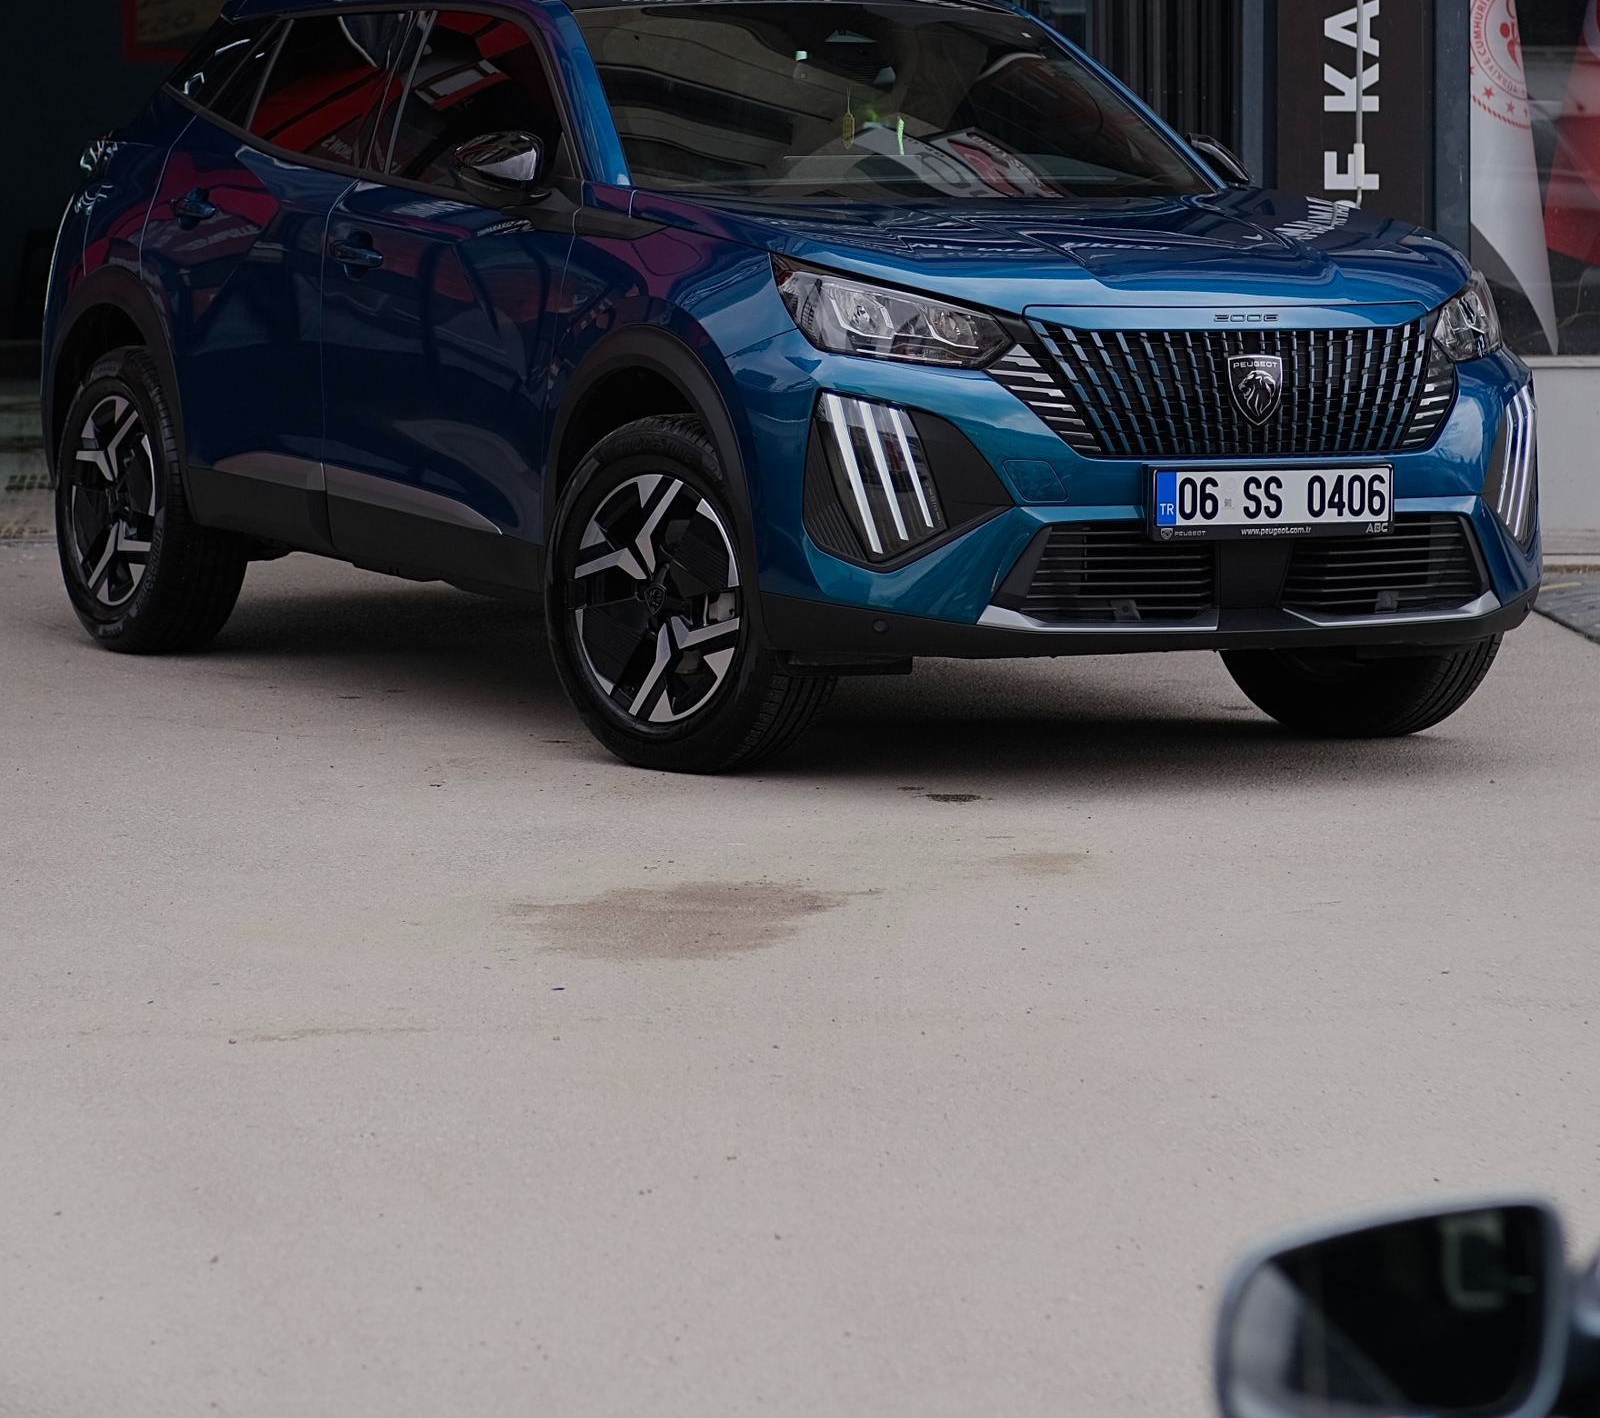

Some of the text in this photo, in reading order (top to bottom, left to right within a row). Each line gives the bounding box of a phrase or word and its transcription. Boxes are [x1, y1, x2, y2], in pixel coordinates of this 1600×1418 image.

[1233, 361, 1278, 369] PEUGEOT
[1160, 474, 1386, 520] TR 06 SS 0406
[1241, 526, 1312, 536] www.peugeot.com.tr
[1366, 523, 1388, 533] ABC
